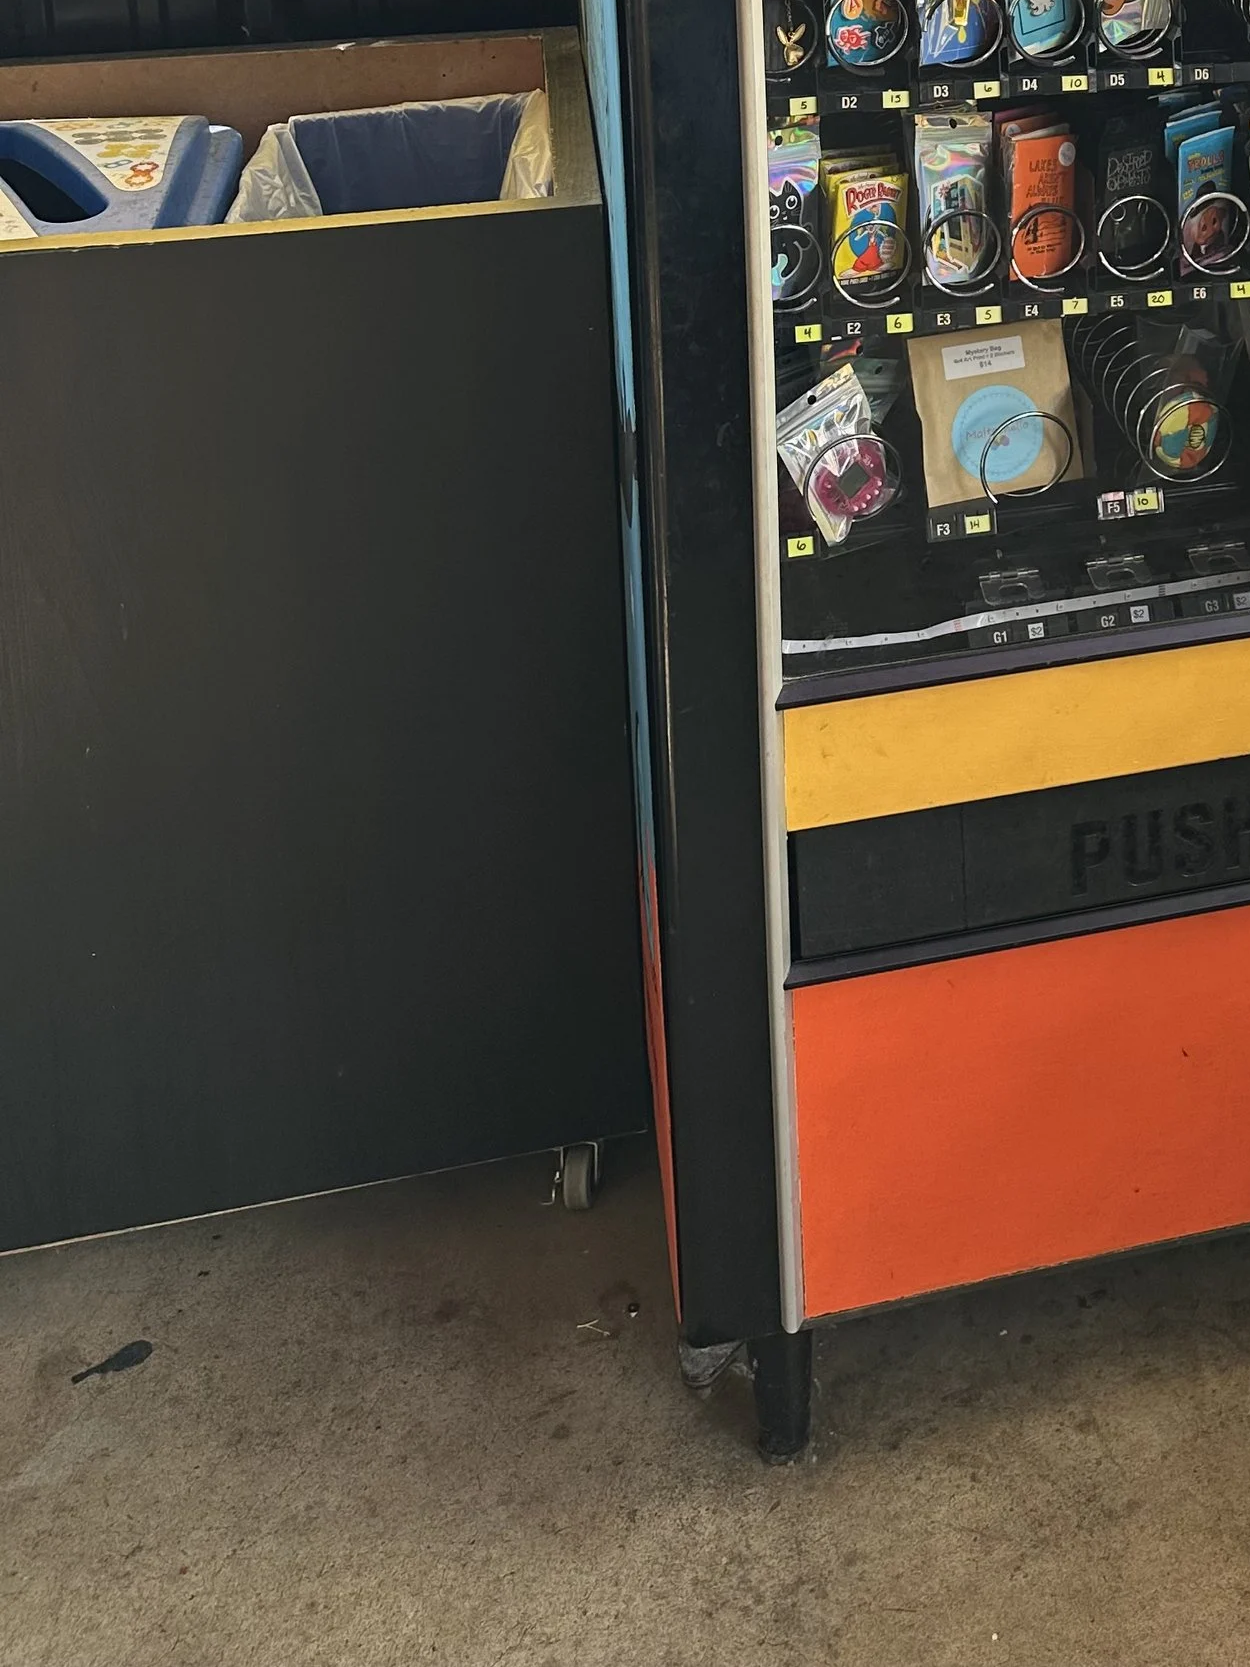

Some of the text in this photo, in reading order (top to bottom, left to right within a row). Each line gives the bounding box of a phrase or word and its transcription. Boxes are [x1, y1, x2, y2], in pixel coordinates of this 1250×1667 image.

[1109, 74, 1125, 86] D5
[1156, 70, 1165, 82] 4
[1194, 68, 1209, 81] D6
[983, 84, 993, 93] 6
[1022, 79, 1039, 91] D4
[1069, 78, 1082, 88] 10
[933, 85, 949, 98] D3
[800, 100, 808, 110] 5
[841, 96, 858, 109] D2
[890, 94, 901, 104] 15
[1193, 287, 1207, 299] E6
[1236, 284, 1246, 295] 4
[1071, 300, 1079, 310] 7
[1110, 295, 1124, 307] E5
[1151, 294, 1166, 304] 20
[984, 308, 993, 320] 5
[1025, 304, 1039, 317] E4
[894, 316, 902, 328] 6
[937, 313, 951, 326] E3
[804, 327, 812, 338] 4
[847, 322, 861, 335] E2
[965, 347, 989, 356] Mystery
[979, 360, 993, 368] $14
[1107, 501, 1121, 514] F5
[1136, 497, 1149, 506] 10
[936, 523, 950, 536] F3
[969, 518, 980, 530] 14
[796, 539, 807, 551] 6
[1204, 600, 1220, 613] G3
[1236, 596, 1248, 607] $2
[1132, 608, 1146, 620] $2
[1101, 615, 1116, 628] G2
[993, 630, 1008, 644] G1
[1030, 626, 1043, 637] $2
